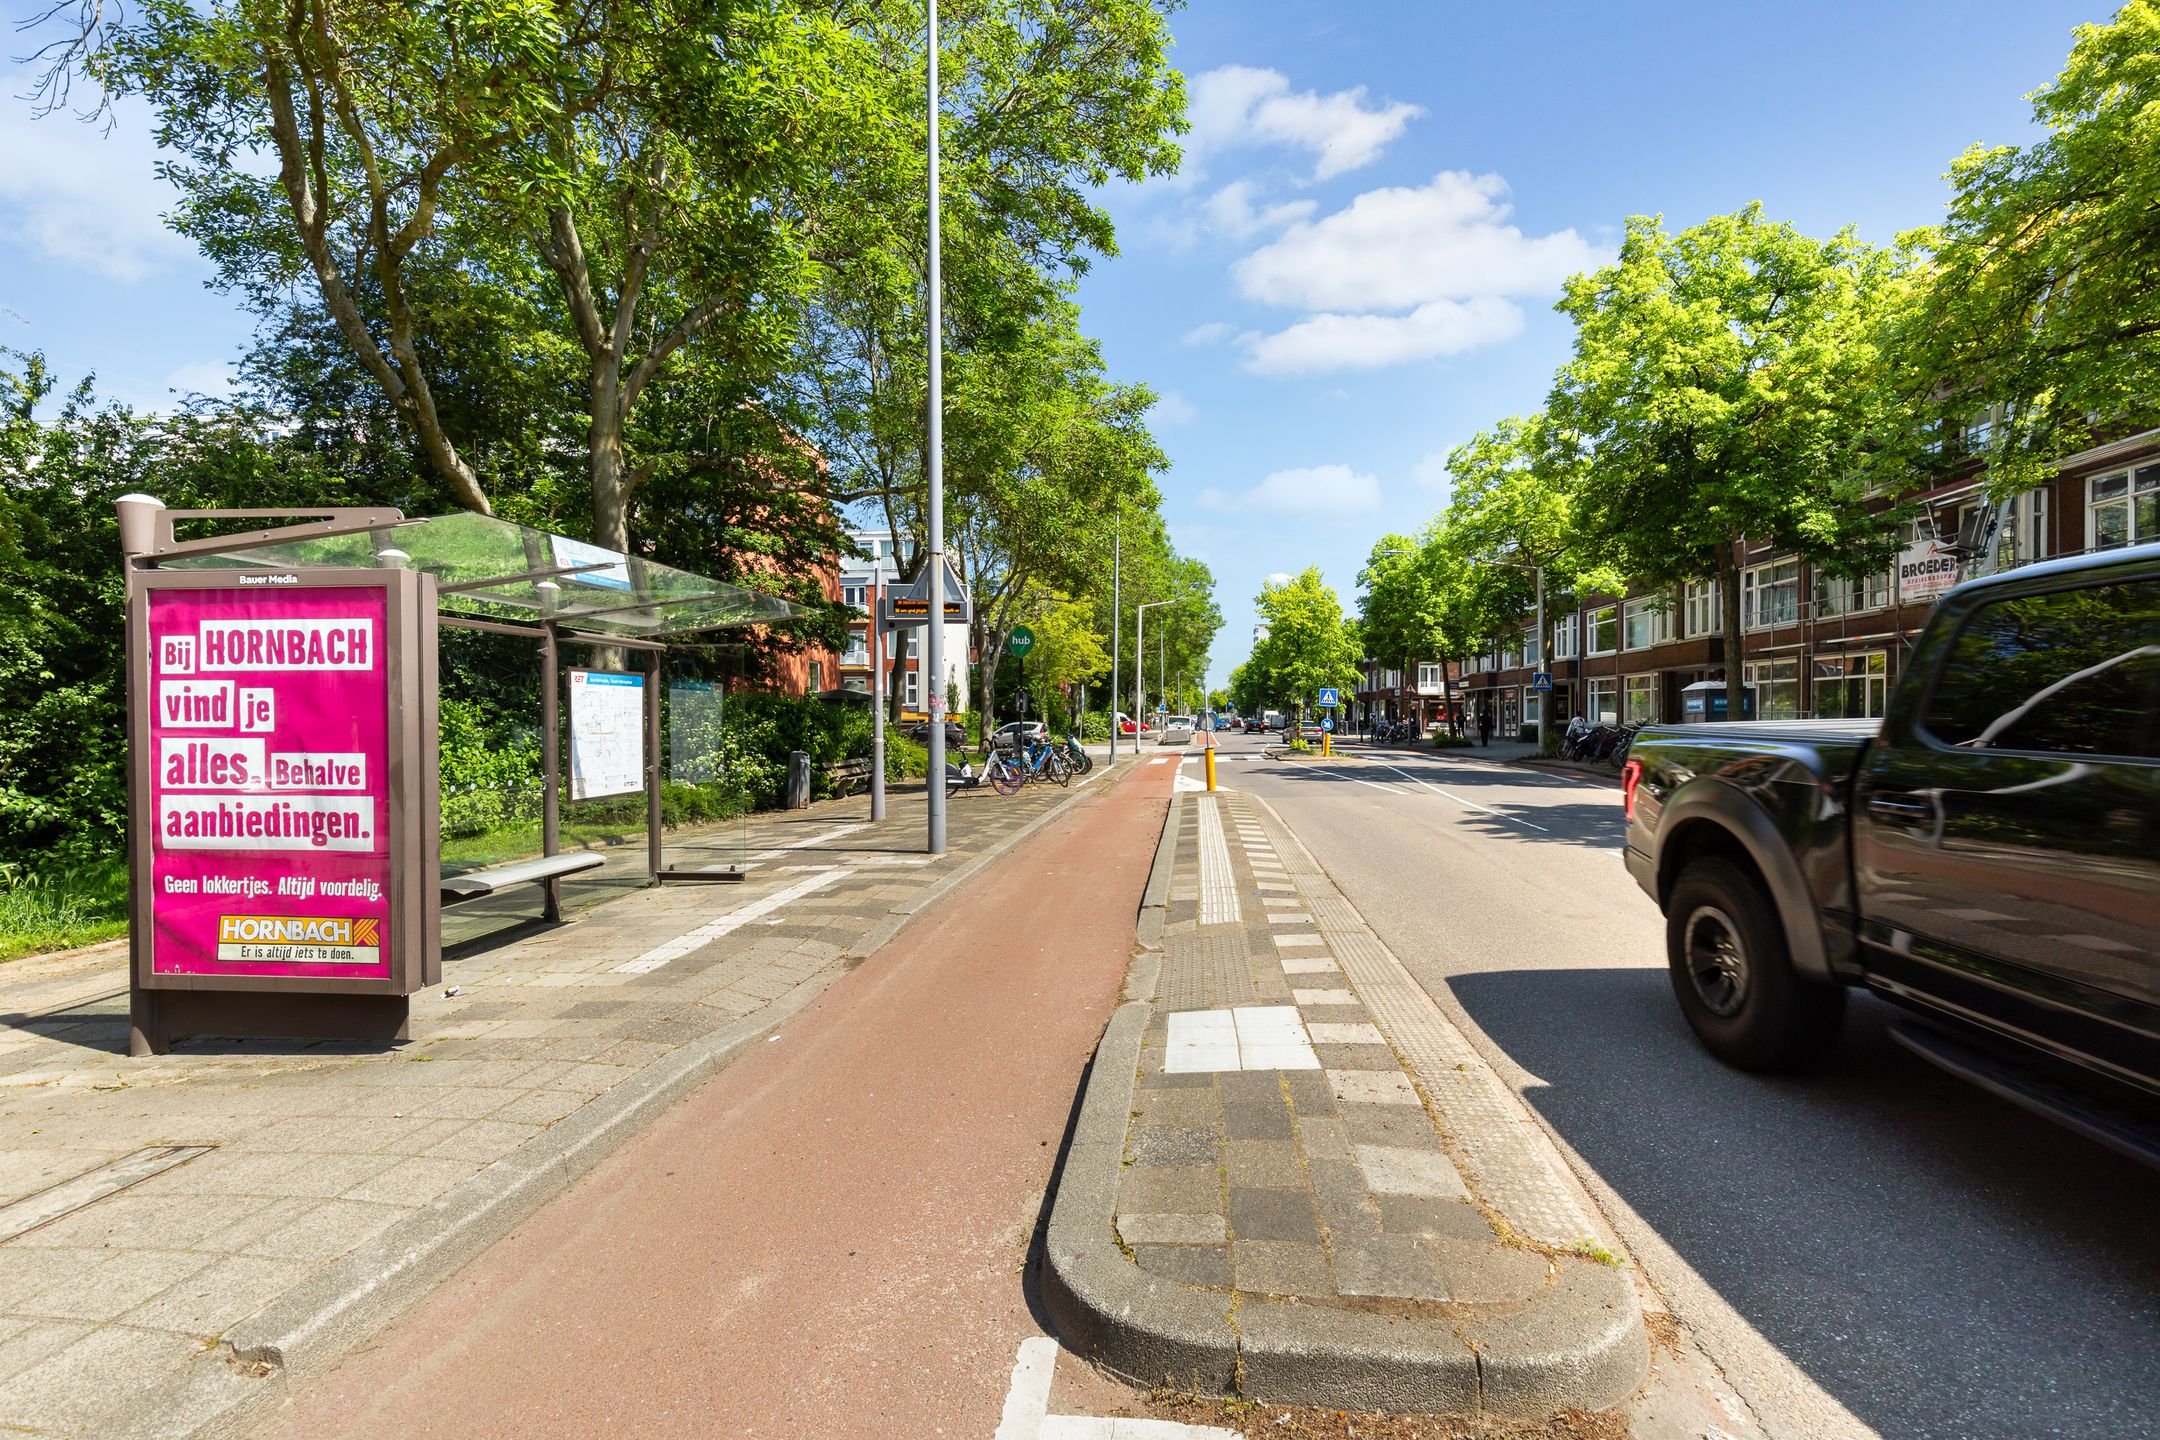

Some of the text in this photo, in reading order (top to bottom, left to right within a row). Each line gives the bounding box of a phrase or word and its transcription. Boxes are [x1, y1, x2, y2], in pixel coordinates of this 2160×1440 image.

[240, 575, 298, 584] Bauer Media
[165, 628, 367, 671] Bij HORNBACH
[1012, 635, 1030, 645] hub
[166, 685, 270, 730] vind je
[166, 742, 361, 786] alles. Behalve
[166, 801, 371, 847] aanbiedingen.
[163, 875, 383, 901] Geen lokkertjes. Altijd voordelig.
[222, 918, 350, 943] HORNBACH
[241, 946, 354, 960] Er is altijd iets te doen.
